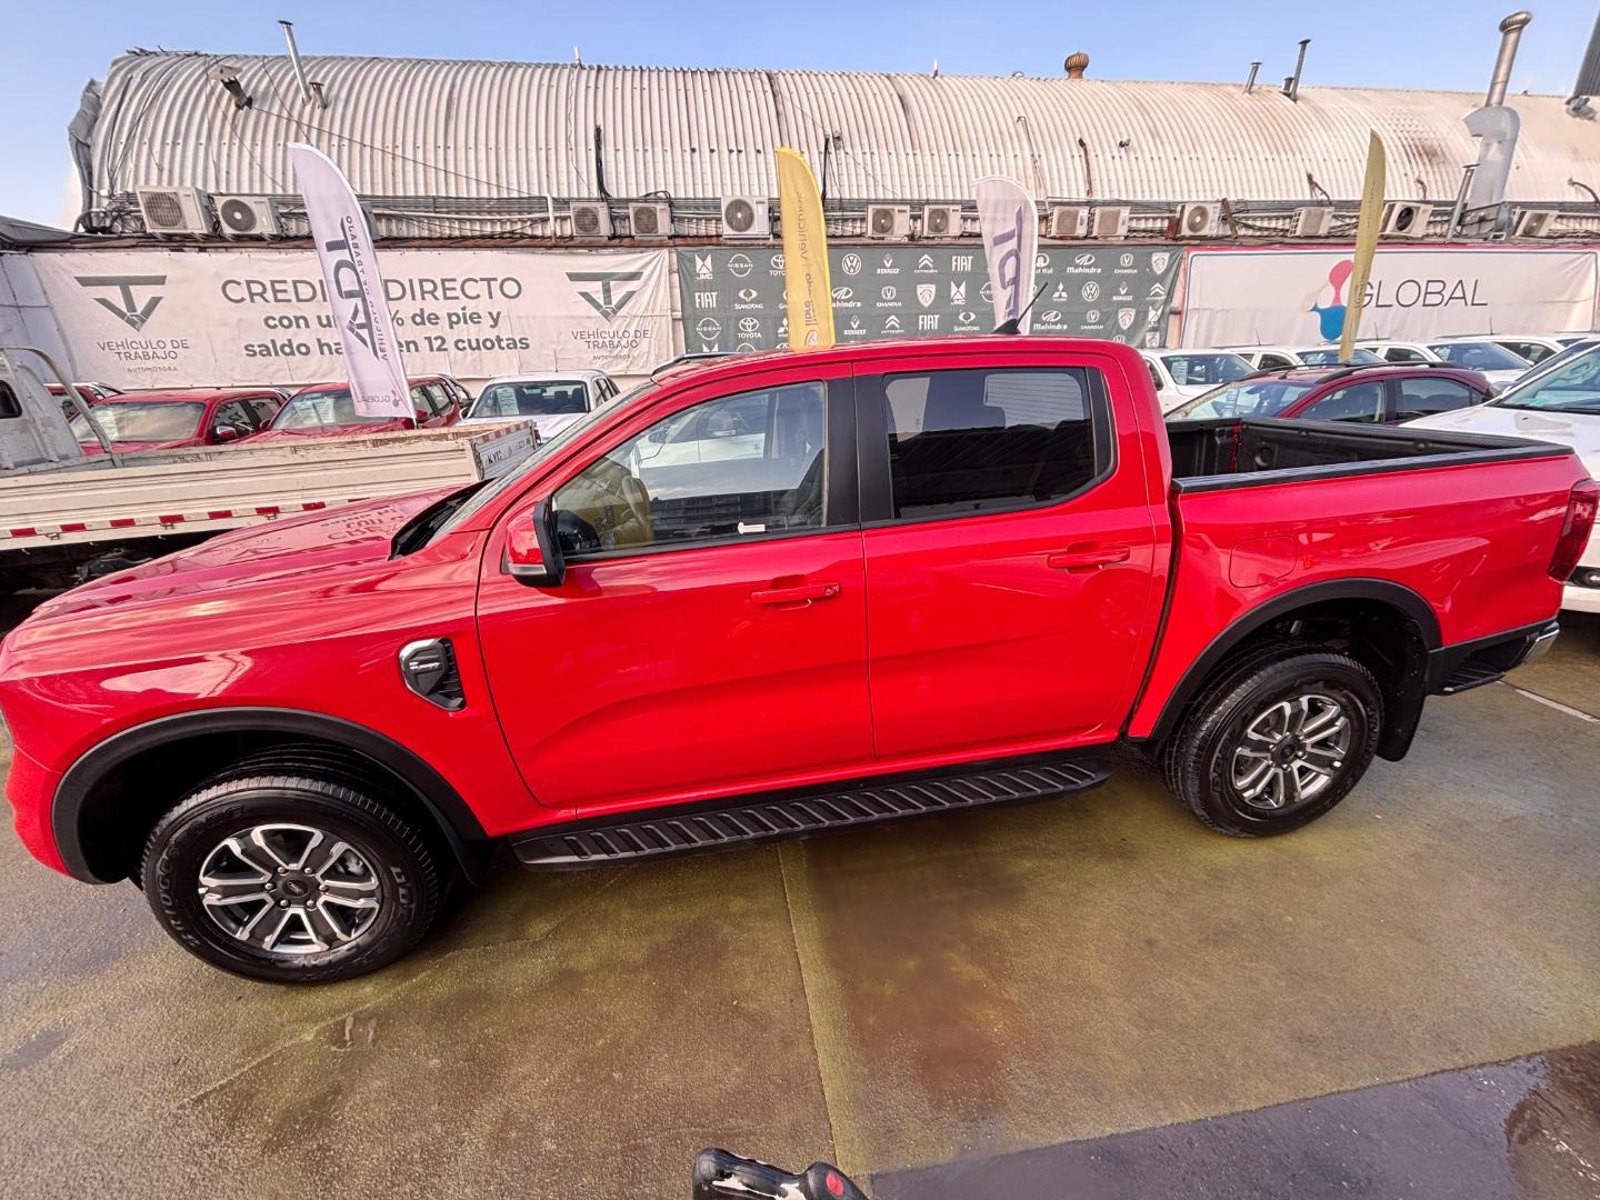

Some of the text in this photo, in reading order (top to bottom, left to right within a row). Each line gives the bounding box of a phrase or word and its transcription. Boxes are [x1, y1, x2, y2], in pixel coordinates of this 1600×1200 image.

[952, 255, 974, 272] FIAT
[221, 276, 522, 304] CREDI DIRECTO
[695, 291, 718, 309] FIAT
[263, 314, 310, 329] con
[411, 308, 441, 327] de
[489, 311, 501, 329] y
[918, 314, 940, 330] FIAT
[571, 328, 650, 340] VEHÍCULO DE
[97, 338, 190, 351] VEHÍCULO DE
[244, 338, 311, 357] saldo
[425, 336, 448, 352] 12
[454, 335, 530, 352] cuotas
[584, 340, 639, 349] TRABAJO
[114, 350, 178, 361] TRABAJO
